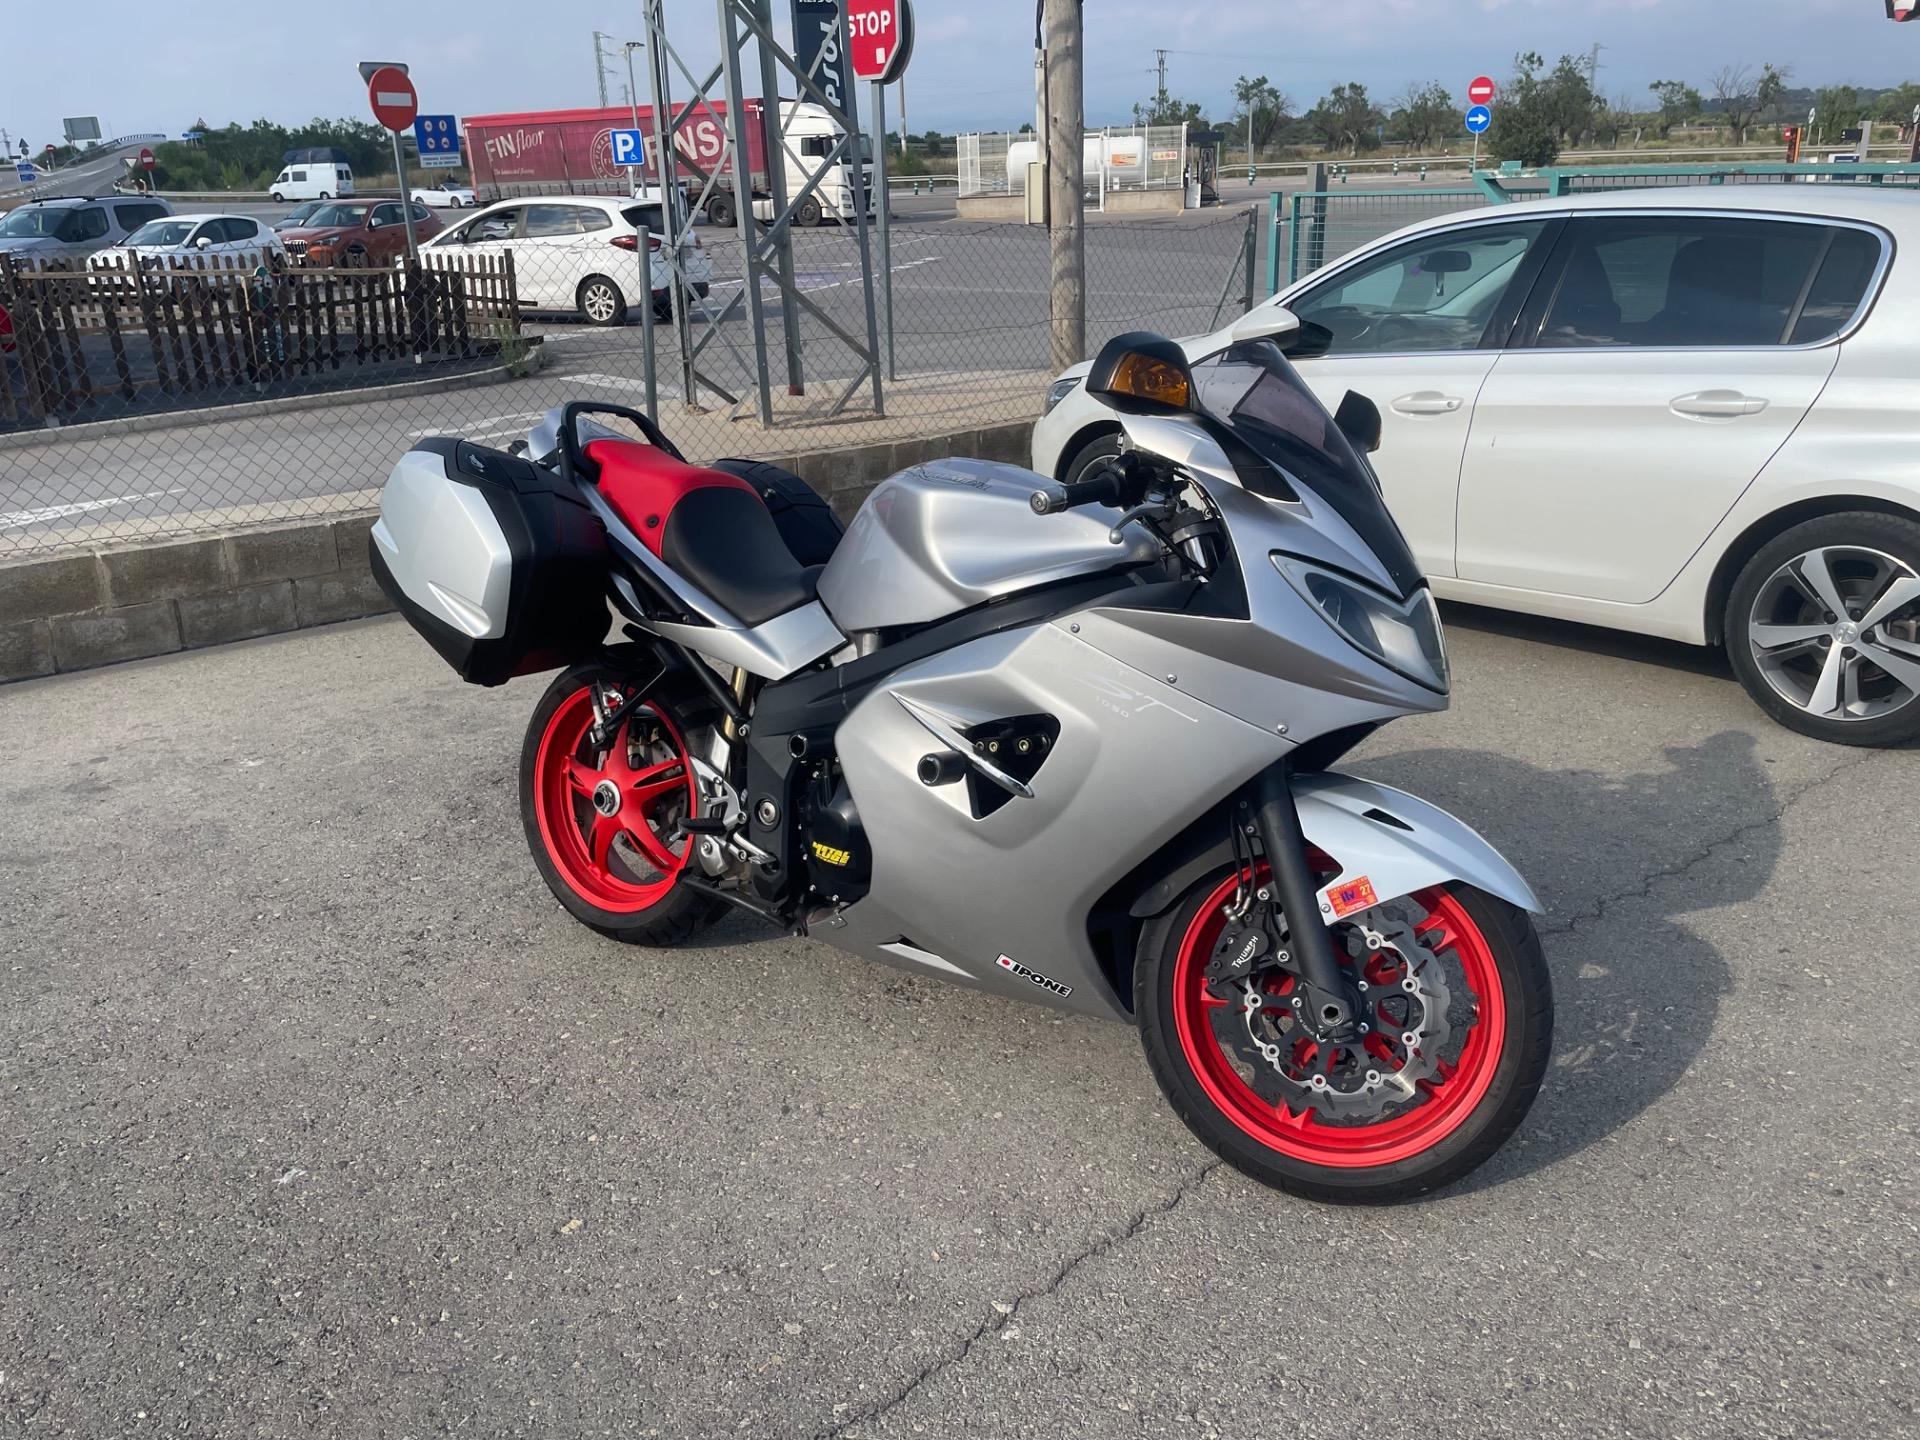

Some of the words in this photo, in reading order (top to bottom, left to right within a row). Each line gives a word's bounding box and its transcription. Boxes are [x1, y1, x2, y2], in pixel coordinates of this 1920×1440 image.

[848, 10, 892, 38] STOP
[615, 133, 634, 161] P
[1359, 884, 1370, 896] 27
[1231, 935, 1259, 968] TRIUMPH
[1012, 963, 1071, 997] IPONE
